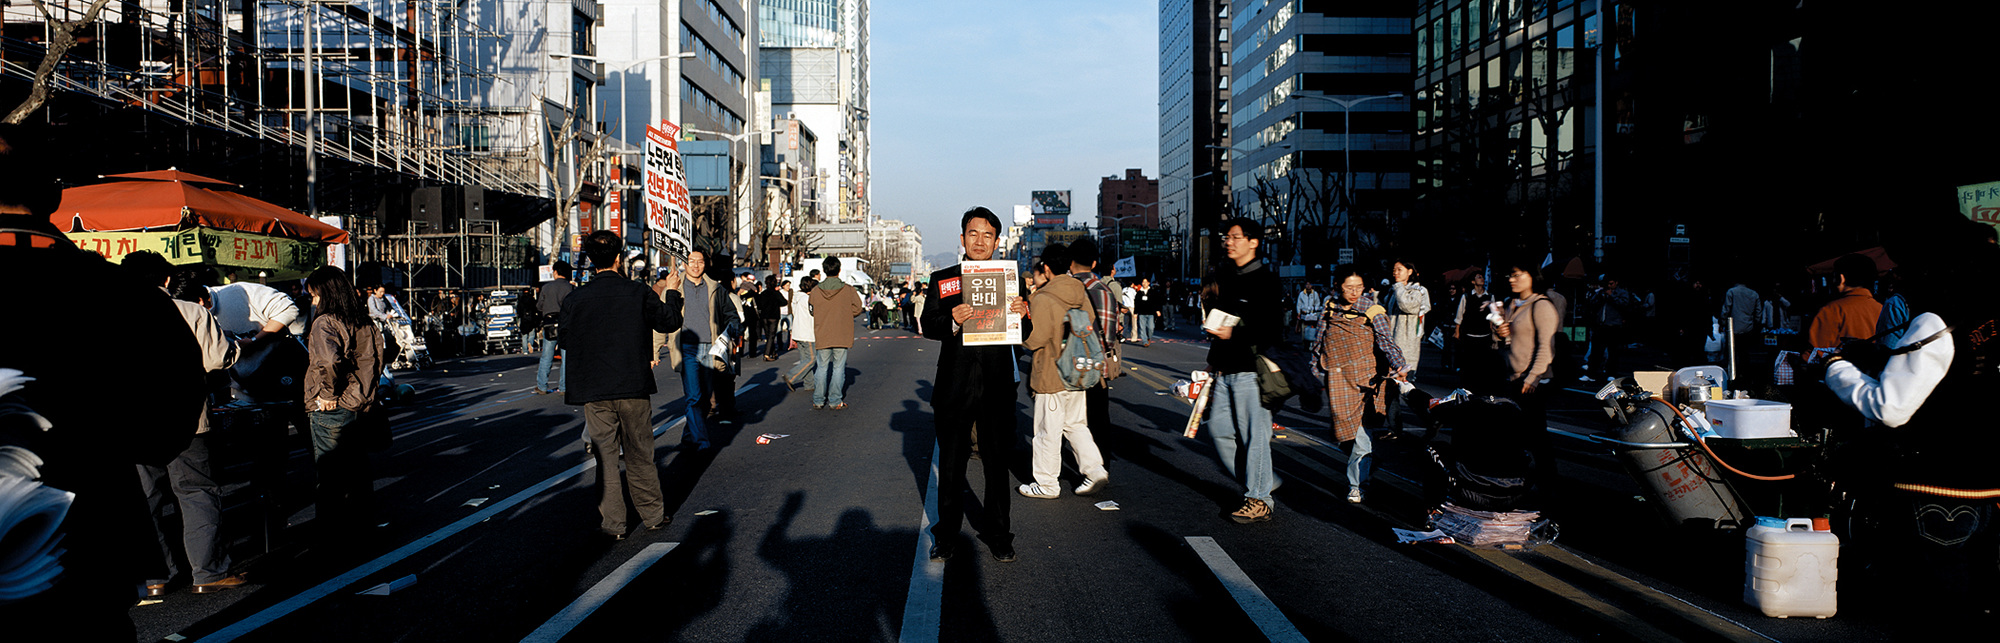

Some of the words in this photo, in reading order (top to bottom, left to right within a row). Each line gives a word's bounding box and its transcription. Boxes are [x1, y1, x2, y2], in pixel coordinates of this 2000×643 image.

[648, 142, 674, 176] 노무현
[647, 170, 665, 200] 진보
[648, 198, 680, 234] 겨냥하고
[161, 232, 222, 260] 계란빵
[234, 237, 279, 263] 닭꼬치
[971, 278, 997, 292] 우익
[971, 292, 997, 306] 반대
[976, 319, 995, 330] 실현
